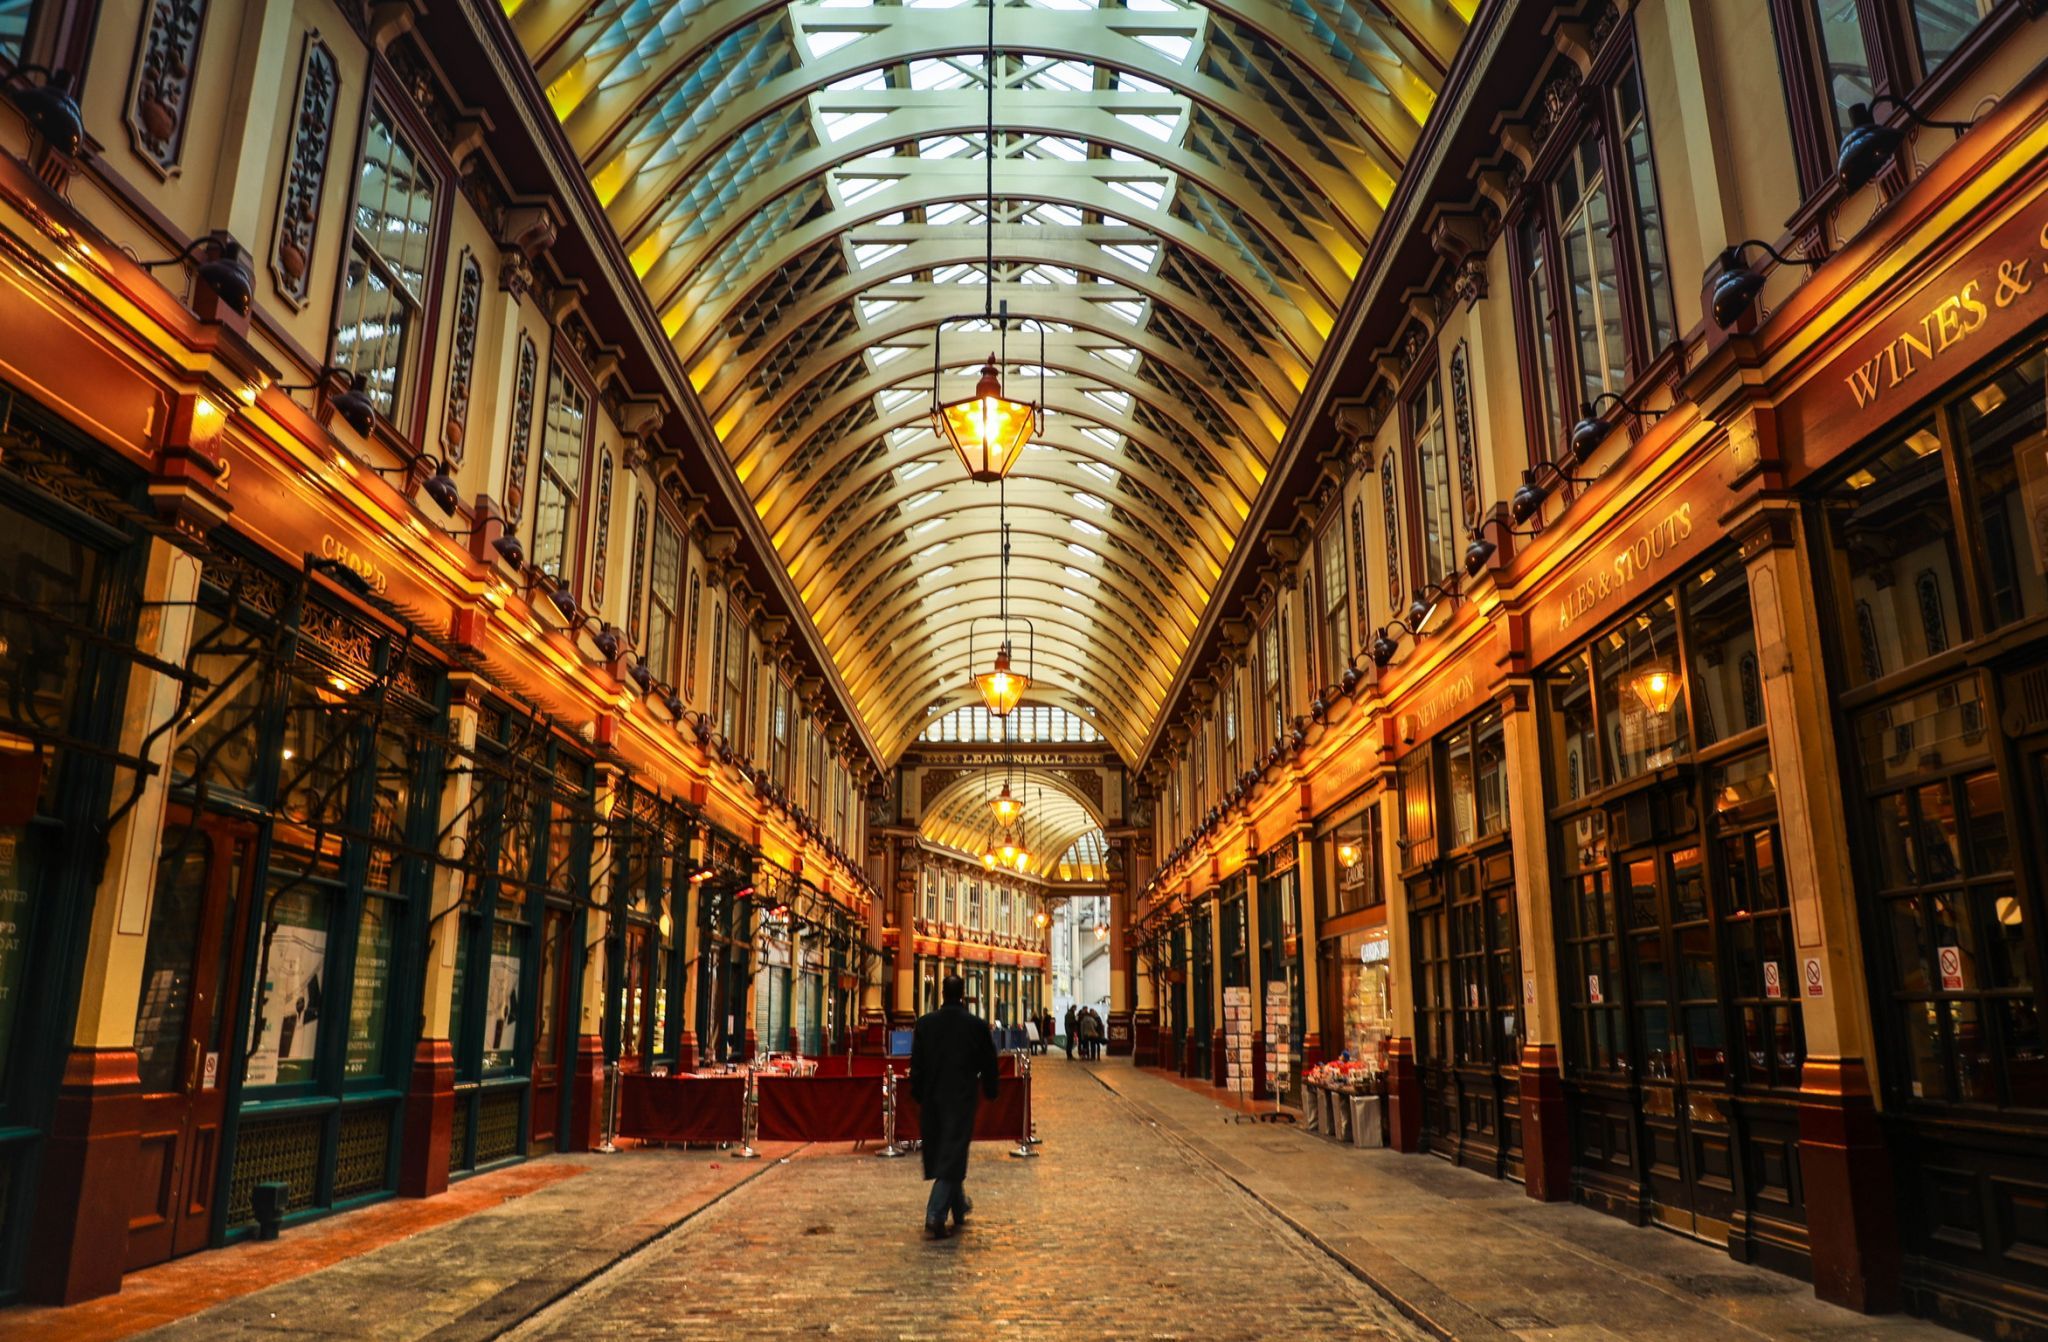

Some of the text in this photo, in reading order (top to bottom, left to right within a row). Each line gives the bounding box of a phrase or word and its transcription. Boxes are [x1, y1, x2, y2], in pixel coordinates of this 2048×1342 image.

[1844, 257, 2033, 410] WINES &
[215, 457, 231, 491] 2
[1558, 501, 1693, 632] ALES & STOUTS
[1417, 671, 1475, 731] NEW MOON
